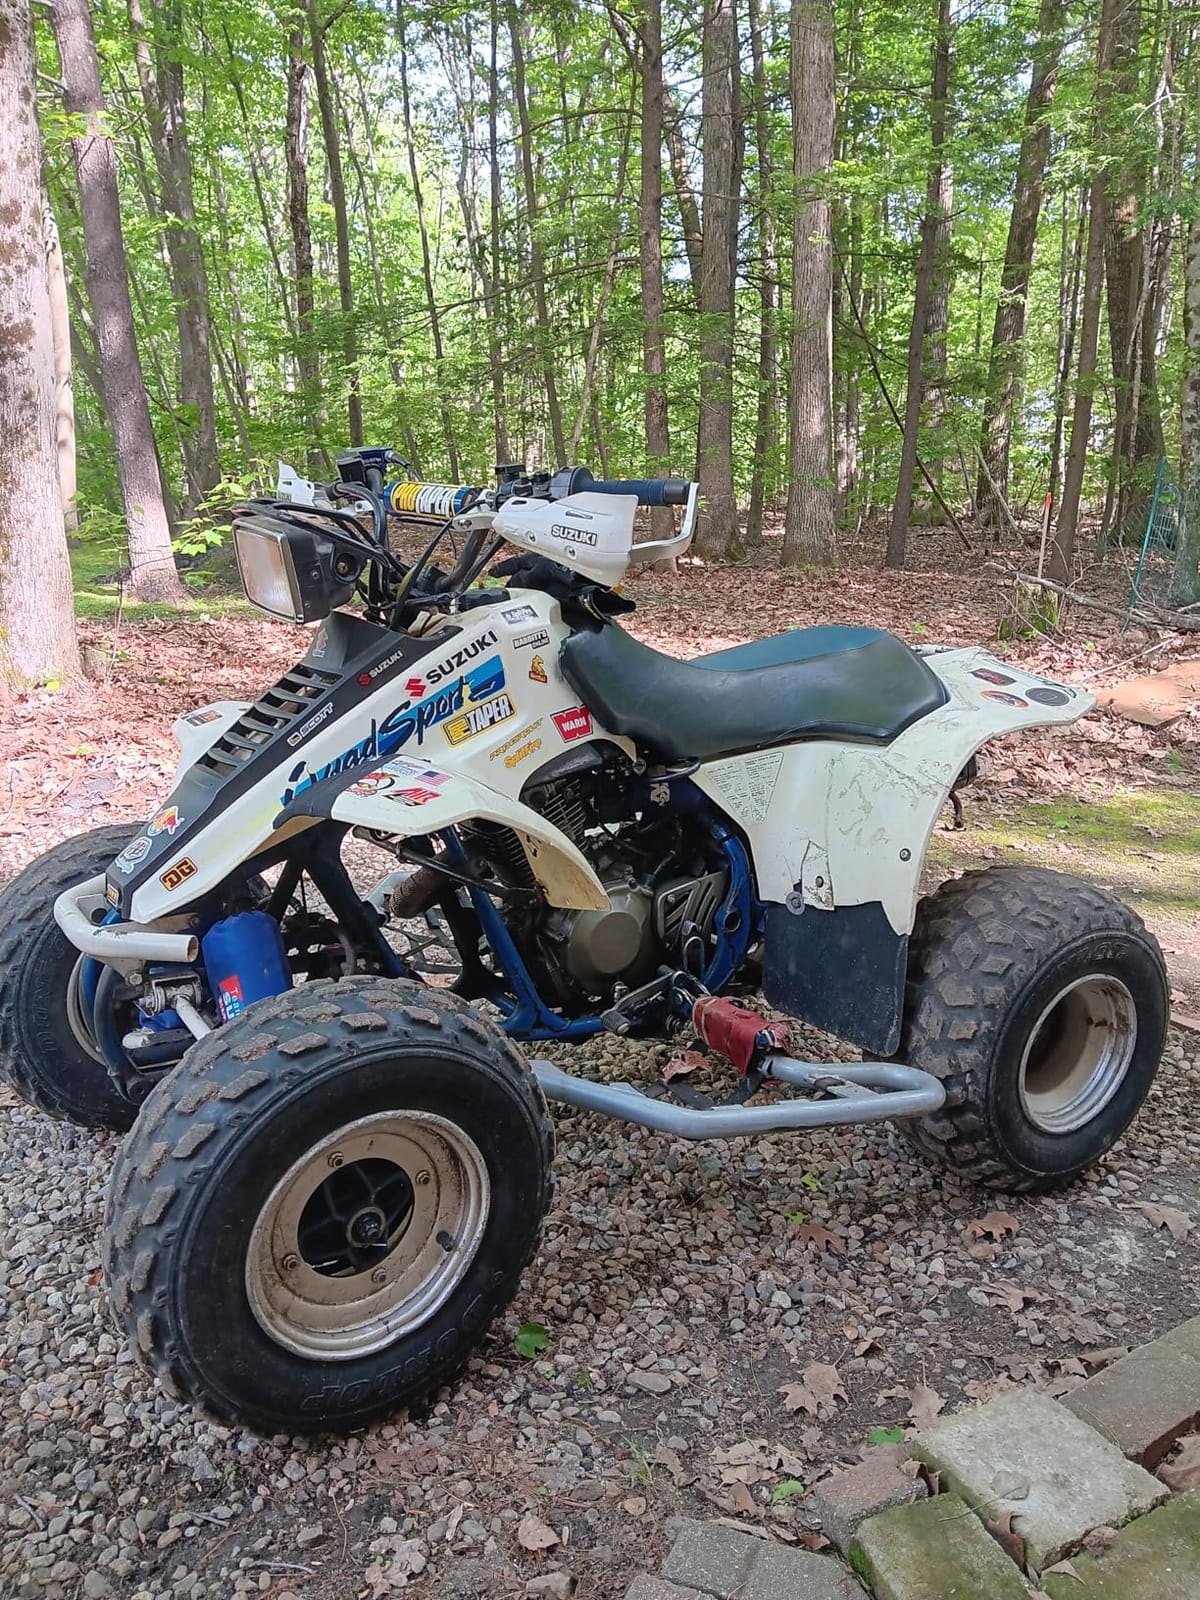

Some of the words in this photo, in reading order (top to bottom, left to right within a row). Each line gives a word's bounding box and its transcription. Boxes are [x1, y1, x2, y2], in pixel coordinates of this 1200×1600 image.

[551, 524, 597, 546] SUZUKI
[369, 650, 404, 678] SUZUKI
[426, 630, 499, 684] SUZUKI
[300, 702, 334, 737] SCOTT
[466, 693, 512, 734] TAPER
[561, 716, 587, 733] WARN
